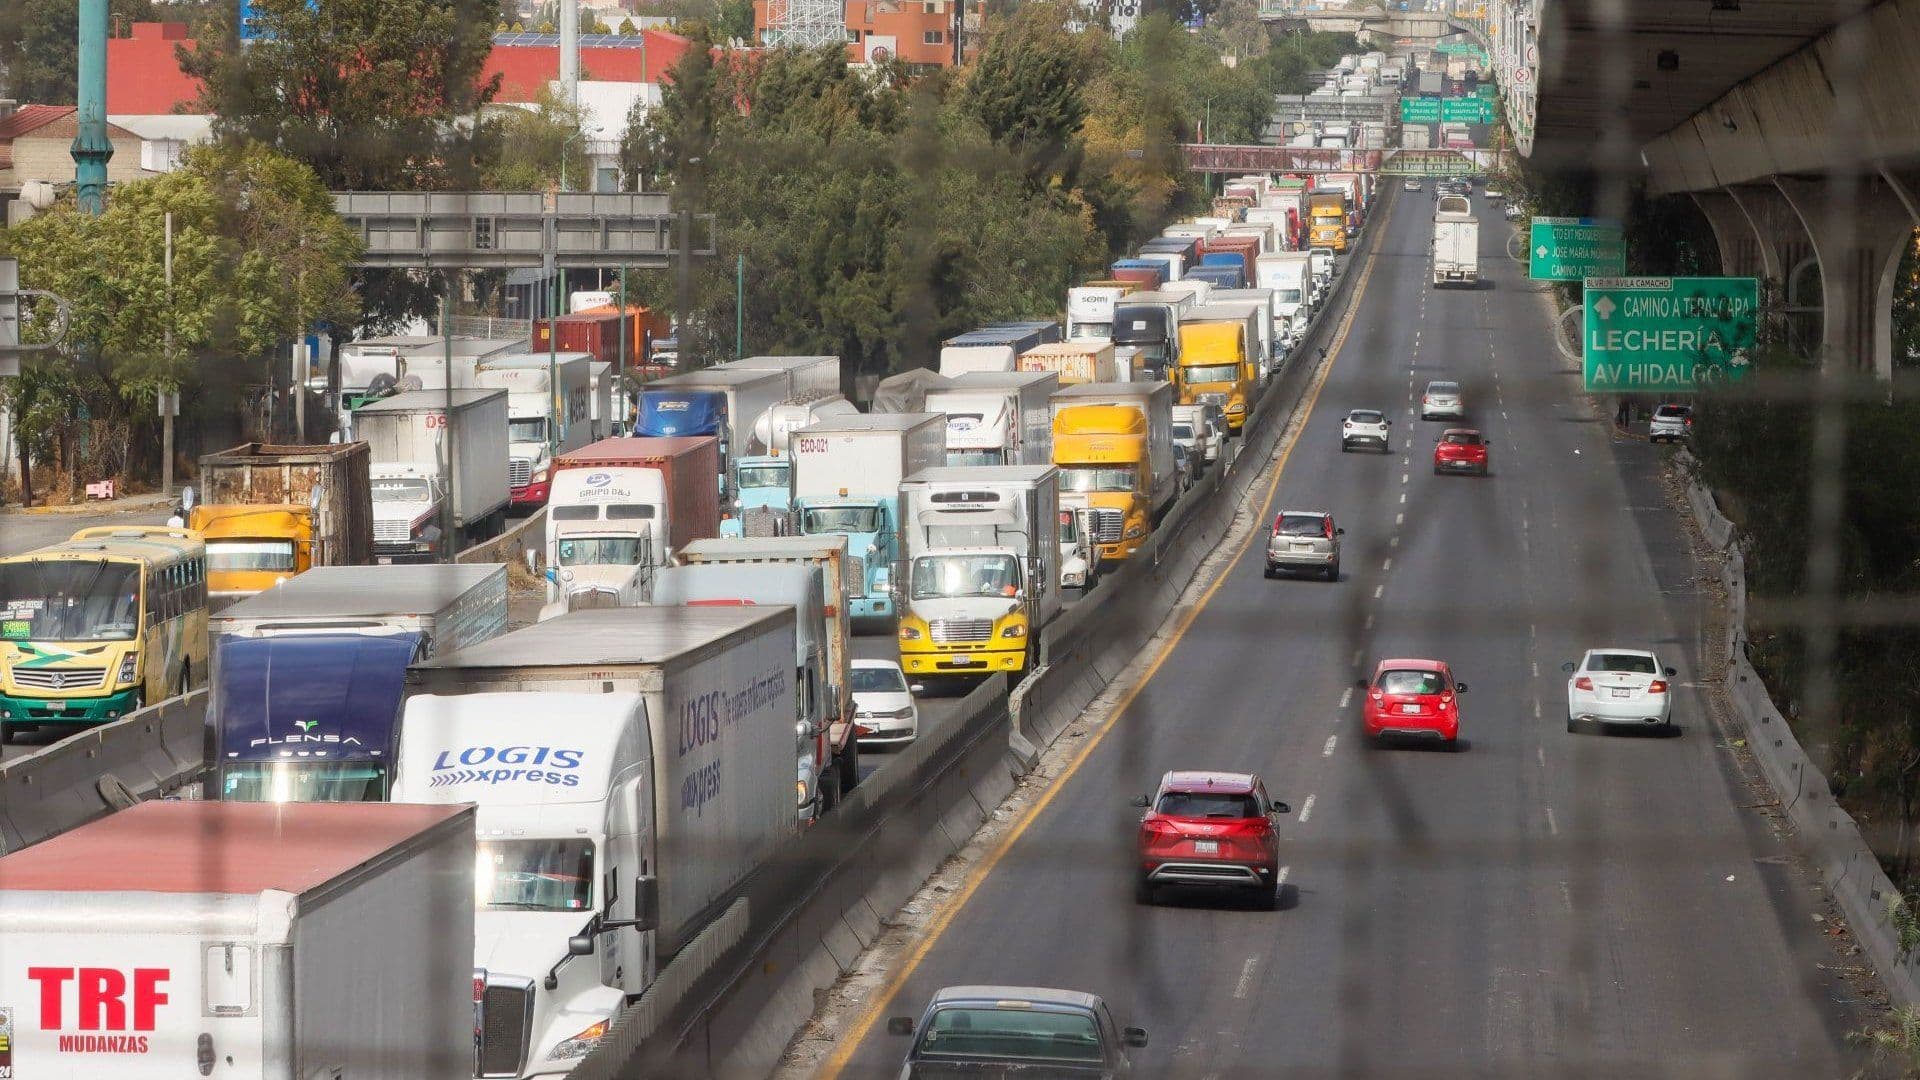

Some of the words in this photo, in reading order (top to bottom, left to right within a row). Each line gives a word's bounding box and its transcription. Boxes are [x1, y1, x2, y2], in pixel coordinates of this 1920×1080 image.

[1636, 279, 1669, 288] CAMACHO
[1623, 297, 1669, 318] CAMINO
[1671, 297, 1681, 318] A
[1592, 325, 1723, 351] LECHERÍA
[1592, 363, 1623, 385] AV
[1629, 363, 1723, 385] HIDALGO
[800, 437, 829, 453] ECO-021
[579, 488, 609, 498] GRUPO
[678, 690, 721, 757] LOGIS
[432, 746, 584, 771] LOGIS
[474, 769, 580, 787] xpress
[28, 967, 170, 1031] TRF
[60, 1035, 148, 1053] MUDANZAS
